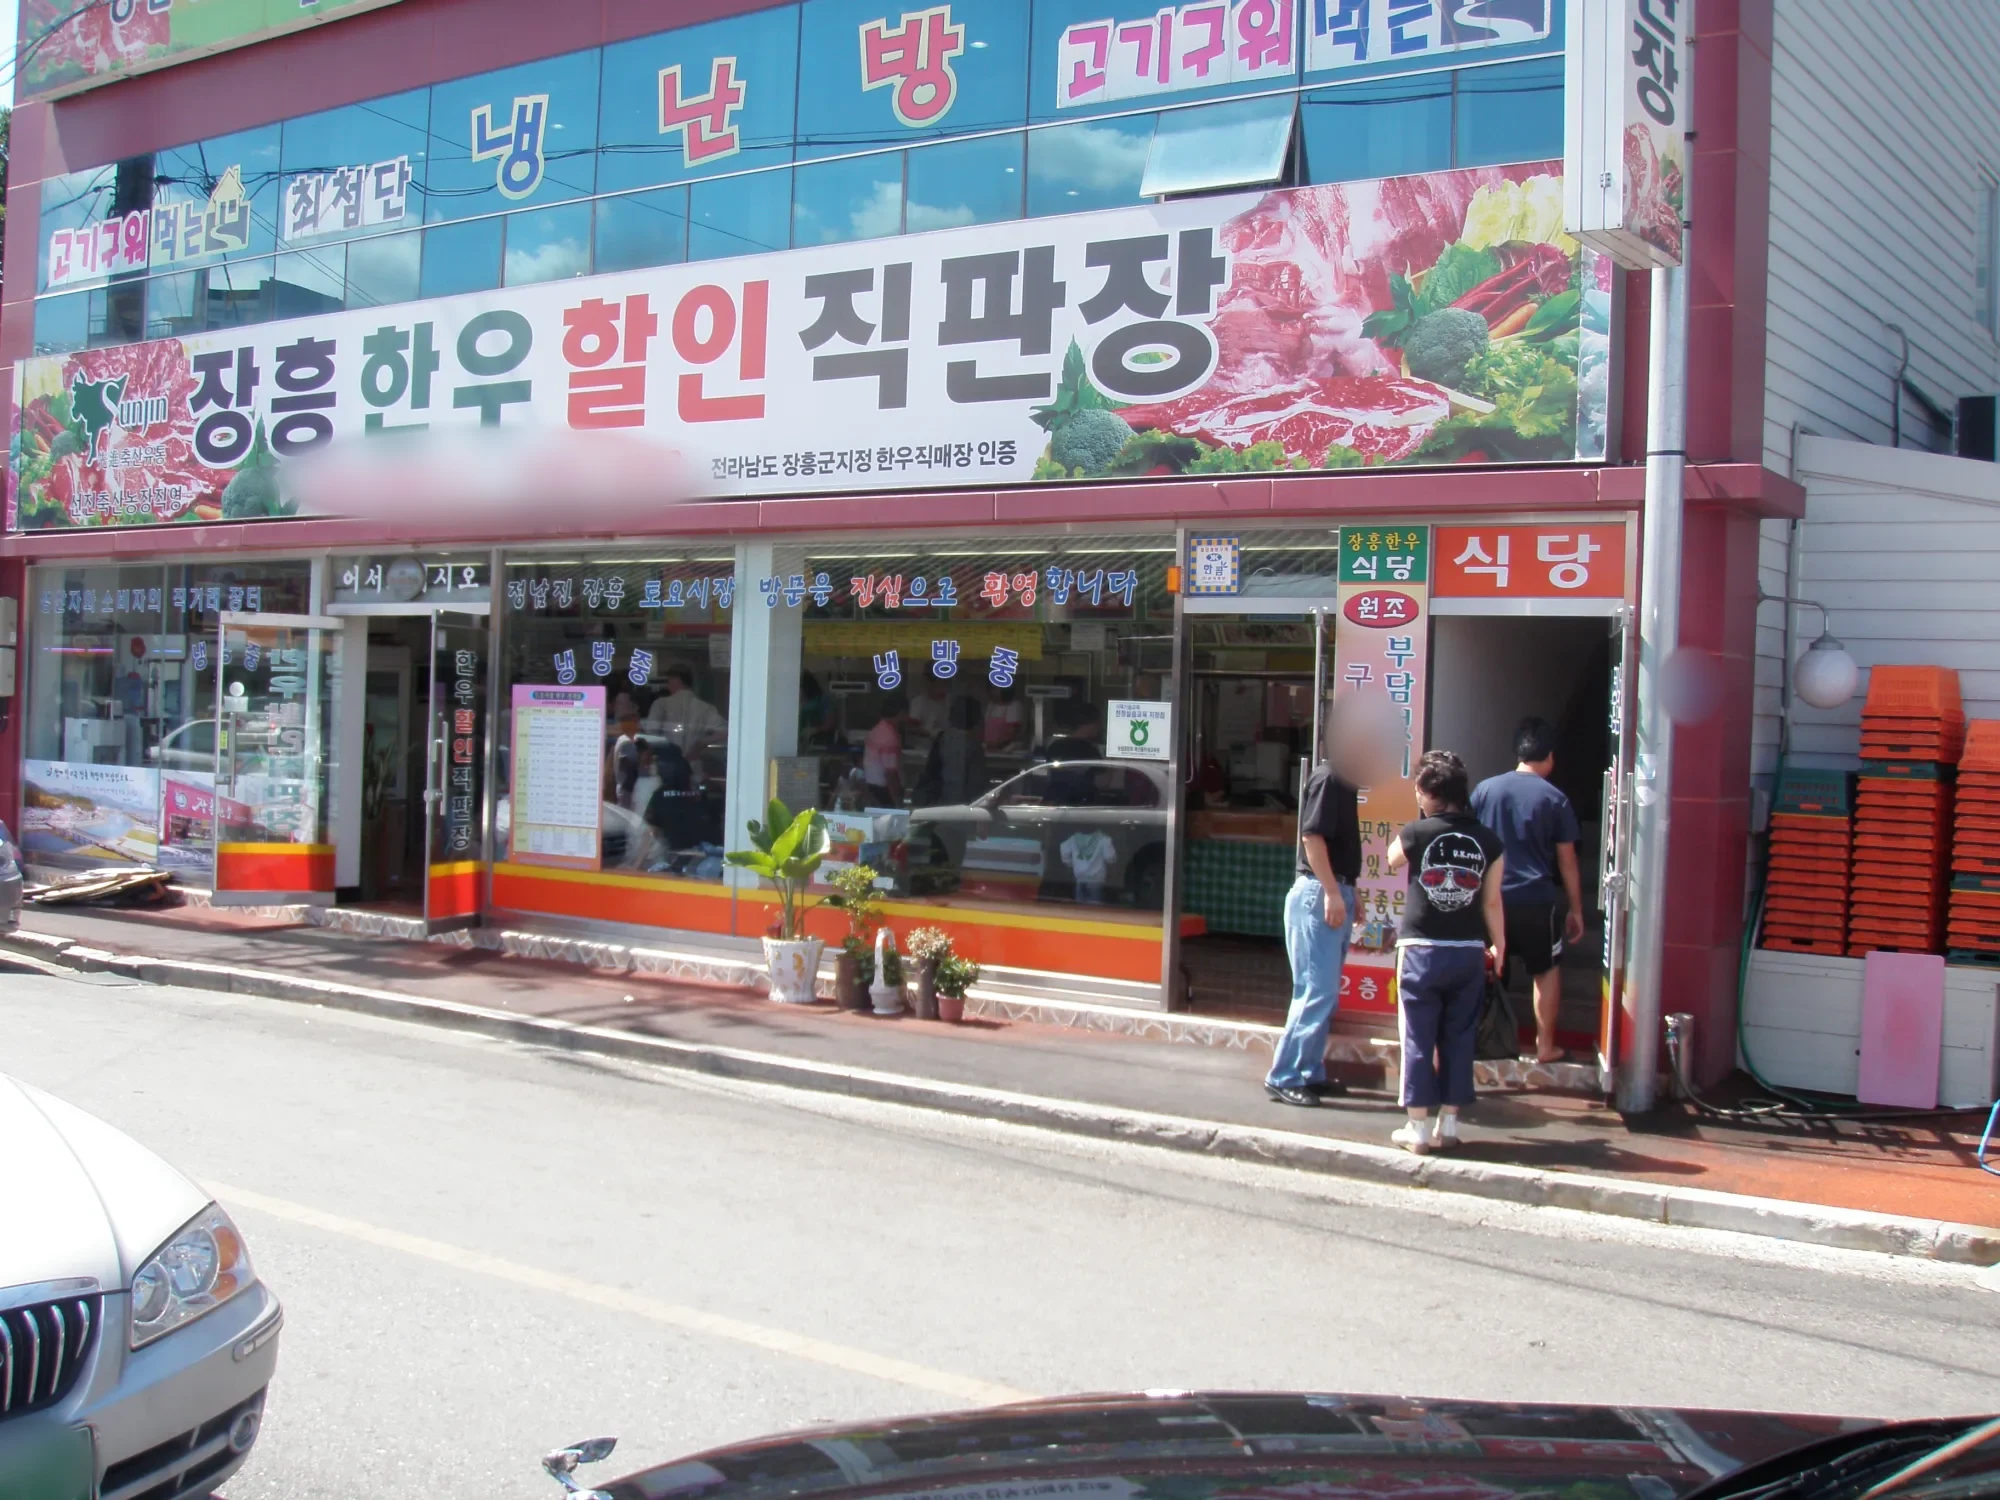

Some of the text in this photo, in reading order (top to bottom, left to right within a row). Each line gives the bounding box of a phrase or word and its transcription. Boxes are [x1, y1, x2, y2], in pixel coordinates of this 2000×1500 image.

[1065, 0, 1297, 100] 고기구워
[292, 158, 411, 232] 최첨단
[53, 206, 205, 280] 고기구워 먹는
[561, 280, 770, 432] 할인
[798, 227, 1226, 410] 직판장
[103, 381, 169, 438] Sunjin
[711, 439, 1017, 480] 전라남도 장흥군지정 한우직매장 인증
[70, 485, 183, 518] 선진축산농장직영
[1347, 532, 1421, 552] 장흥한우
[1453, 534, 1601, 589] 식당
[343, 564, 383, 594] 어서
[507, 565, 1139, 610] 정남진 장흥 토요시장 방문을 진심으로 환영합니다
[1351, 555, 1416, 580] 식당
[172, 588, 222, 613] 직거래
[228, 586, 262, 612] 장터
[1357, 596, 1406, 620] 원조
